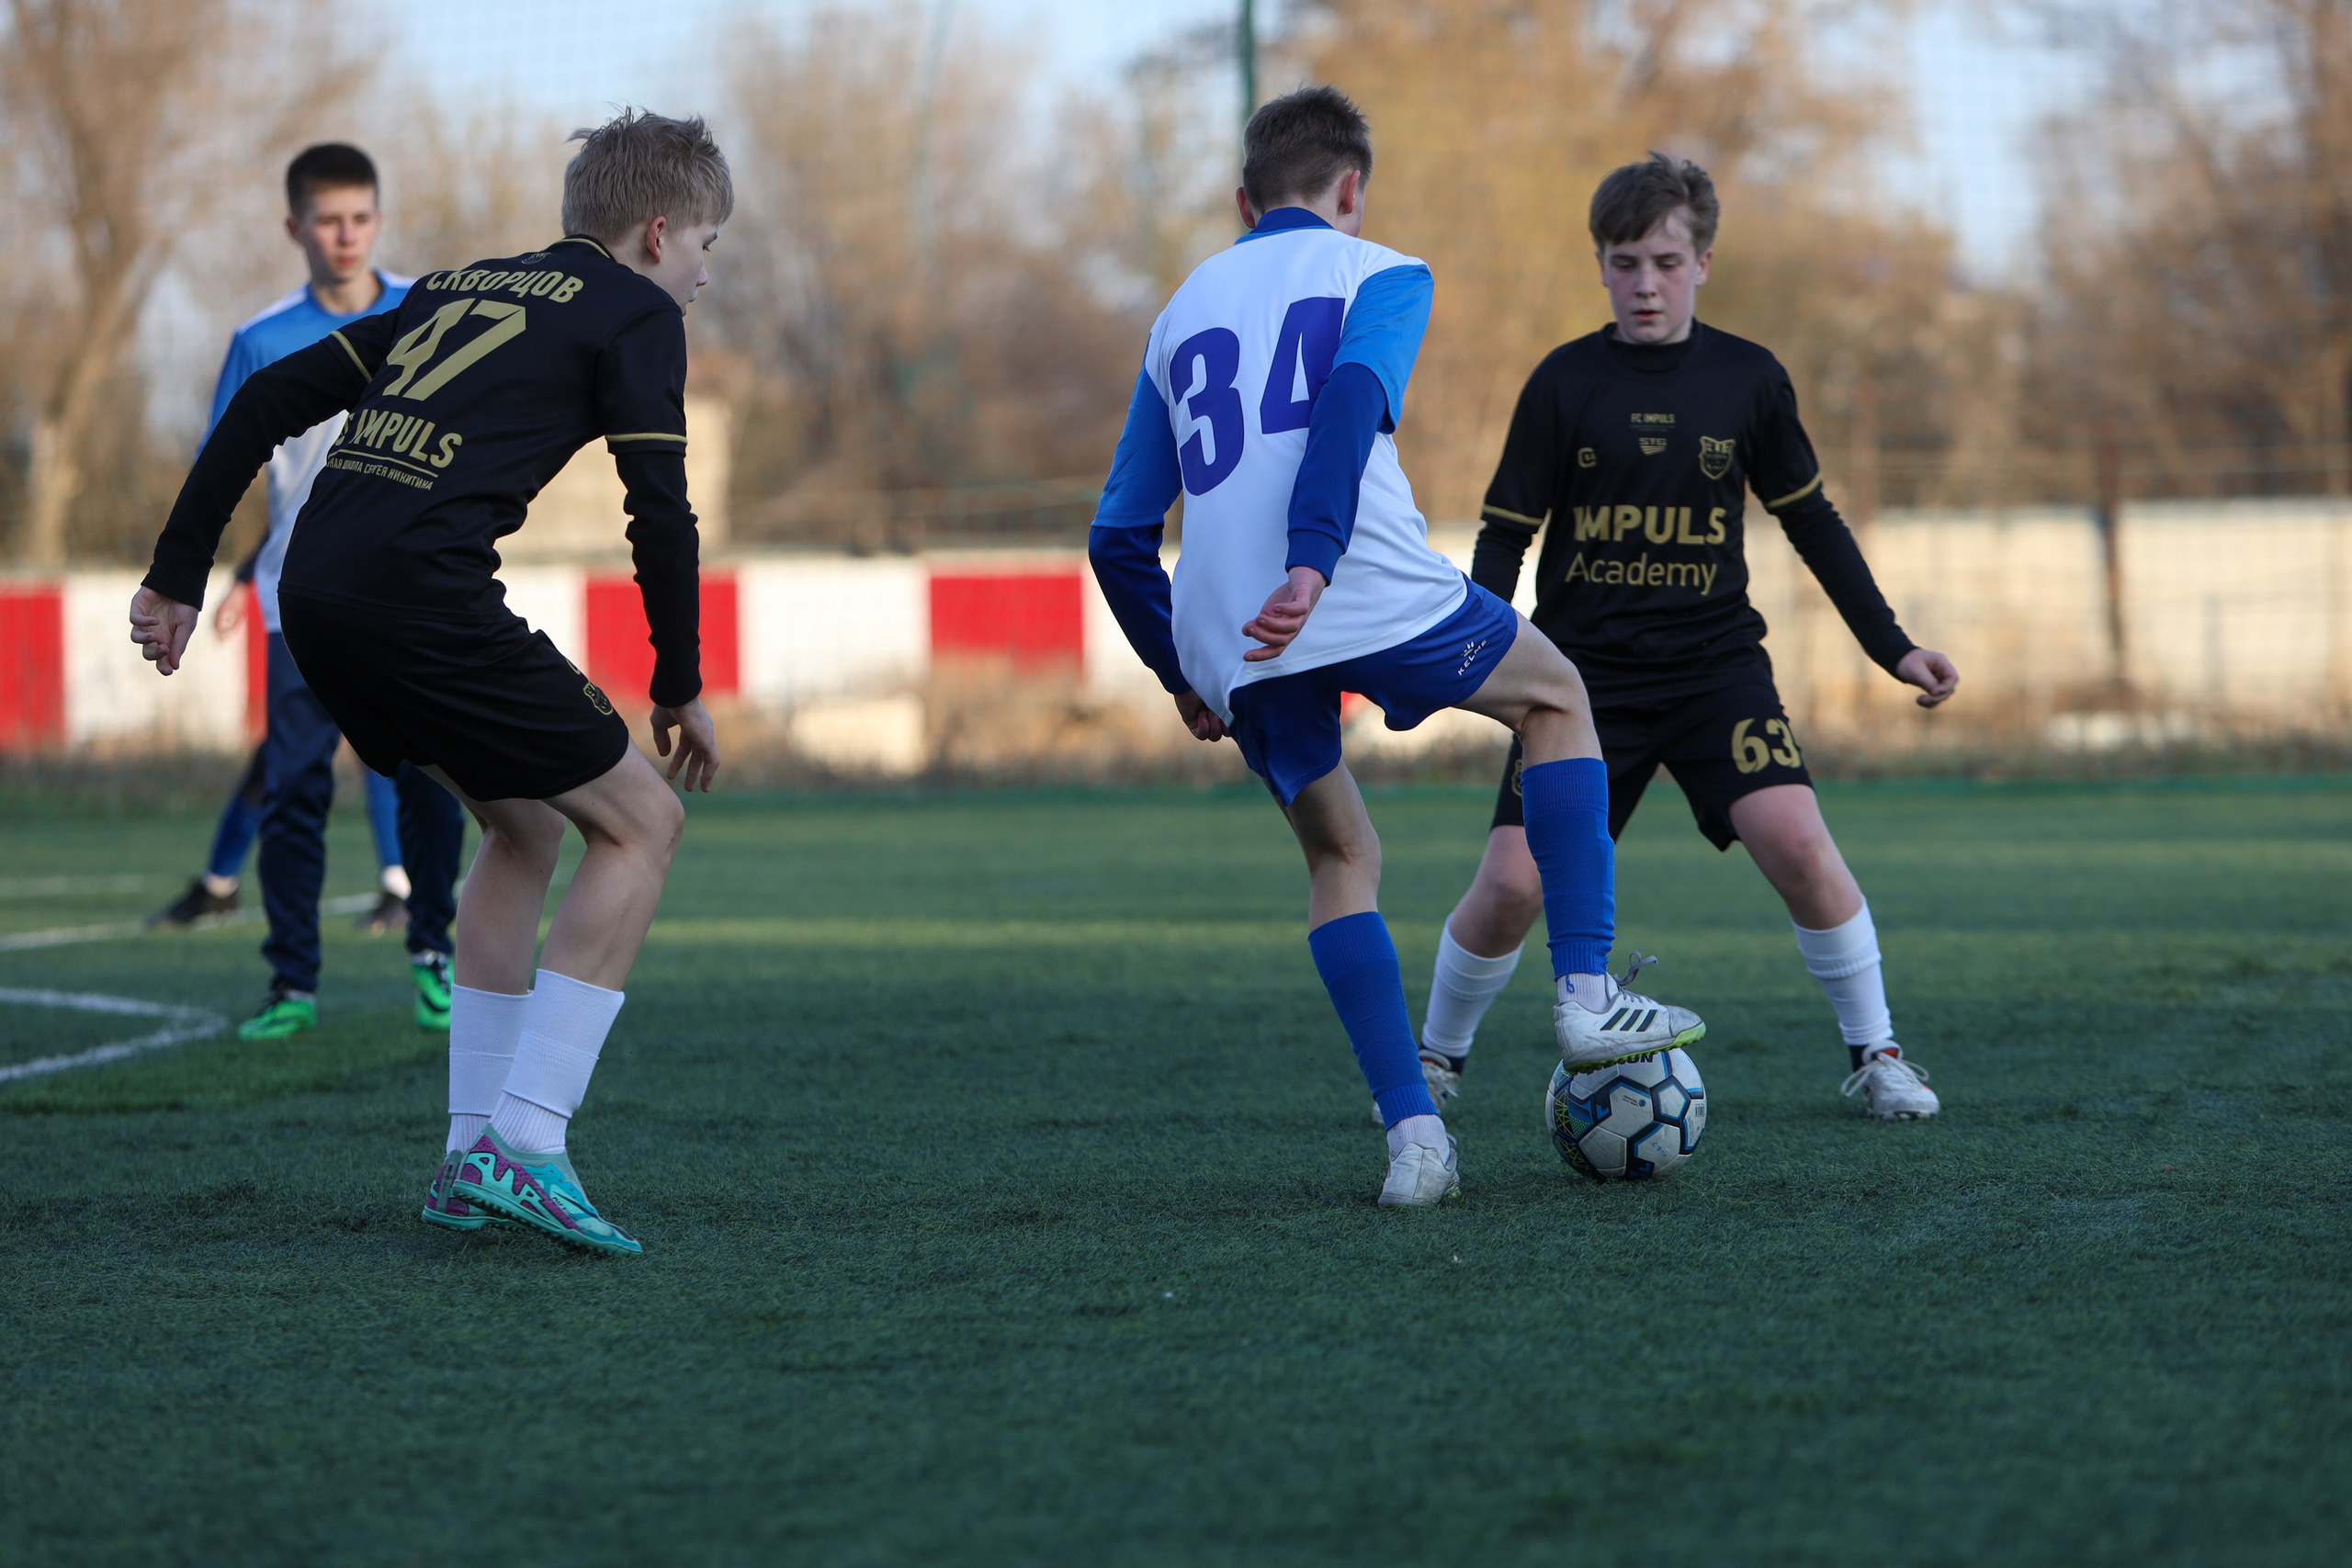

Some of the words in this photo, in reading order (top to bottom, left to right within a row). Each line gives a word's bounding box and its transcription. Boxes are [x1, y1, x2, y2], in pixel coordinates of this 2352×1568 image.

[426, 269, 584, 303] СКВОРЦОВ
[382, 298, 526, 401] 47
[1169, 297, 1346, 496] 34
[348, 409, 463, 468] IMPULS
[1564, 552, 1717, 596] Academy
[1457, 639, 1487, 676] KELME
[1731, 717, 1803, 774] 63
